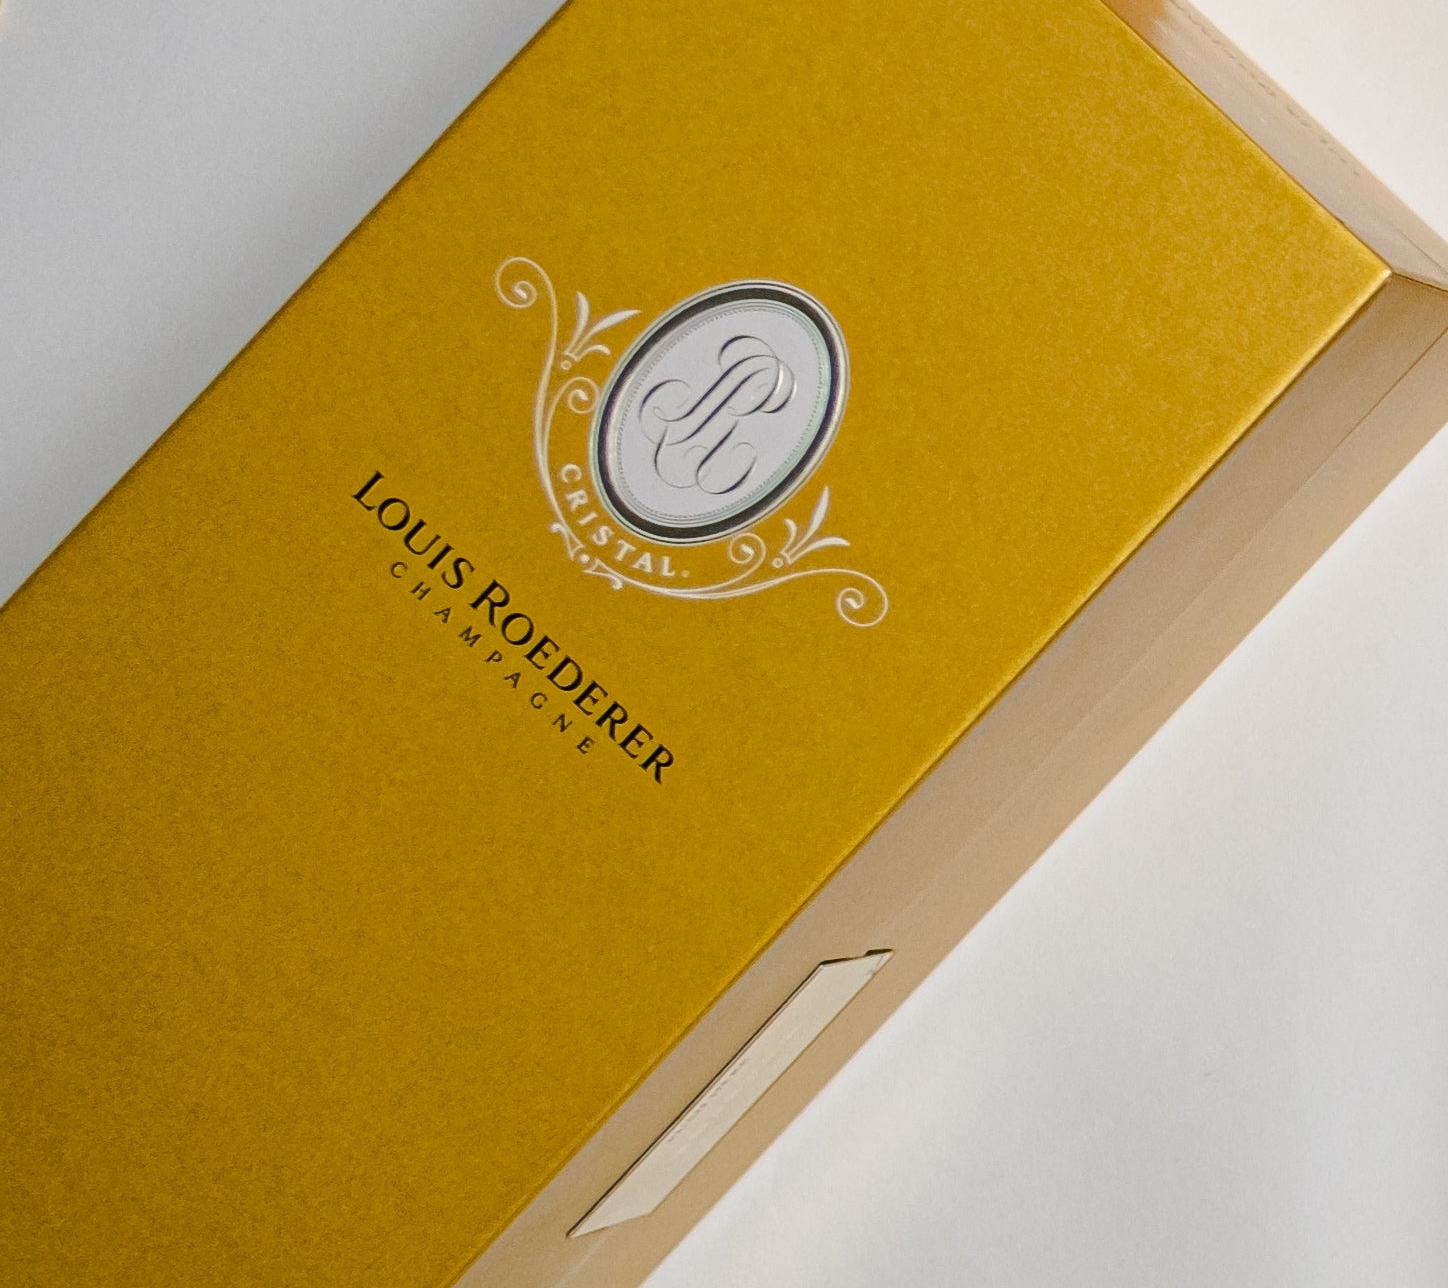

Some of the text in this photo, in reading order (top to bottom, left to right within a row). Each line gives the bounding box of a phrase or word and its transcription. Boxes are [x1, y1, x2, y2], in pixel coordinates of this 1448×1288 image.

[352, 471, 675, 785] LOUIS ROEDERER
[391, 562, 595, 754] CHAMPAGNE
